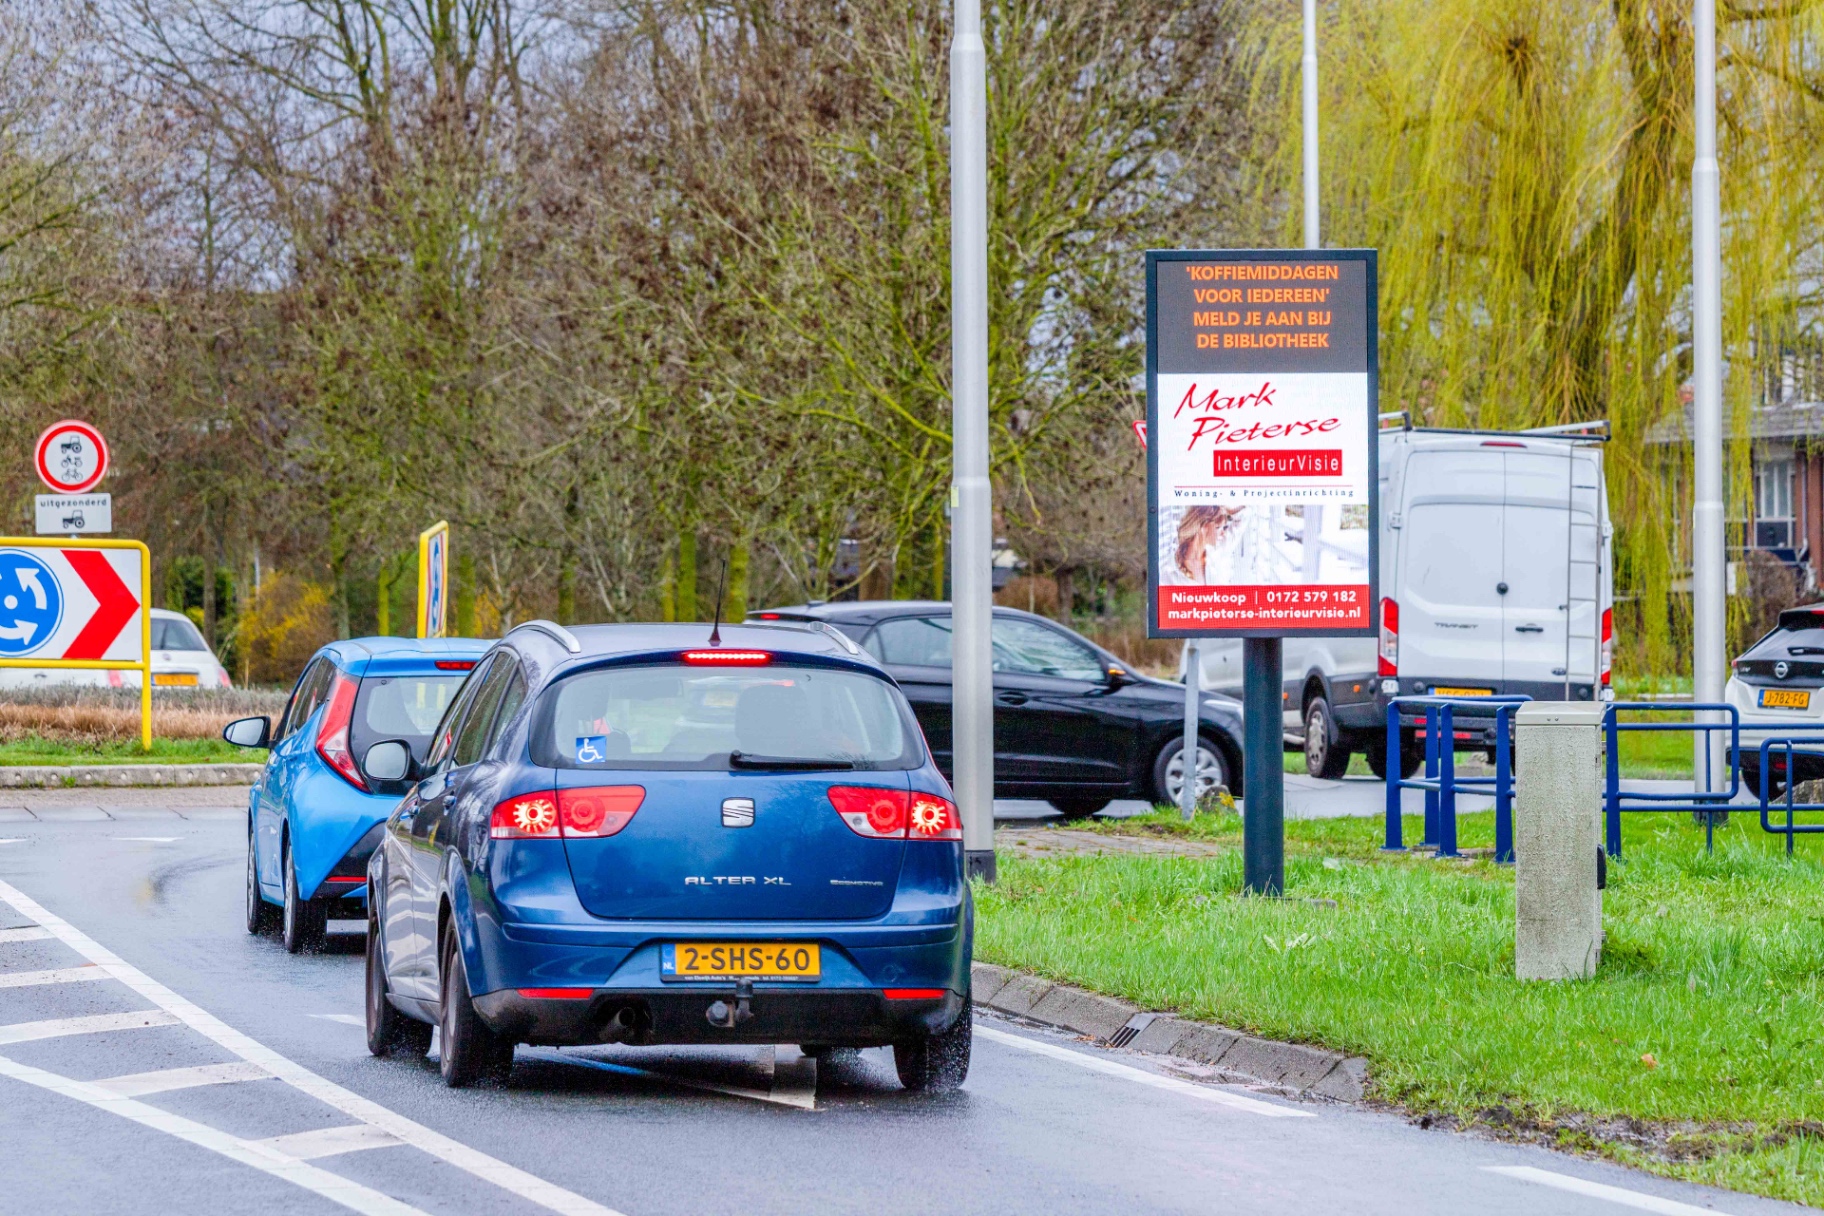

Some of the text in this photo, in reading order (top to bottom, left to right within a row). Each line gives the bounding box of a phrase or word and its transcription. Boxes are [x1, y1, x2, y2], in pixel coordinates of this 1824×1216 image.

[1186, 265, 1339, 281] 'KOFFIEMIDDAGEN
[1193, 288, 1330, 303] VOOR IEDEREEN'
[1193, 311, 1331, 326] MELD JE AAN BIJ
[1196, 333, 1329, 348] DE BIBLIOTHEEK
[1174, 382, 1276, 419] Mark
[1187, 416, 1341, 451] Pieterse
[1217, 455, 1339, 472] InterieurVisie
[1243, 489, 1354, 498] Projectinrichting
[40, 499, 107, 509] uitgezonderd
[1171, 591, 1247, 606] Nieuwkoop
[1266, 591, 1299, 603] 0172
[1304, 591, 1328, 603] 579
[1333, 590, 1356, 603] 182
[1168, 606, 1361, 621] markpieterse-interieurvisie.nl
[763, 876, 792, 886] XL
[663, 962, 674, 970] NL
[684, 947, 811, 971] 2-SHS-60
